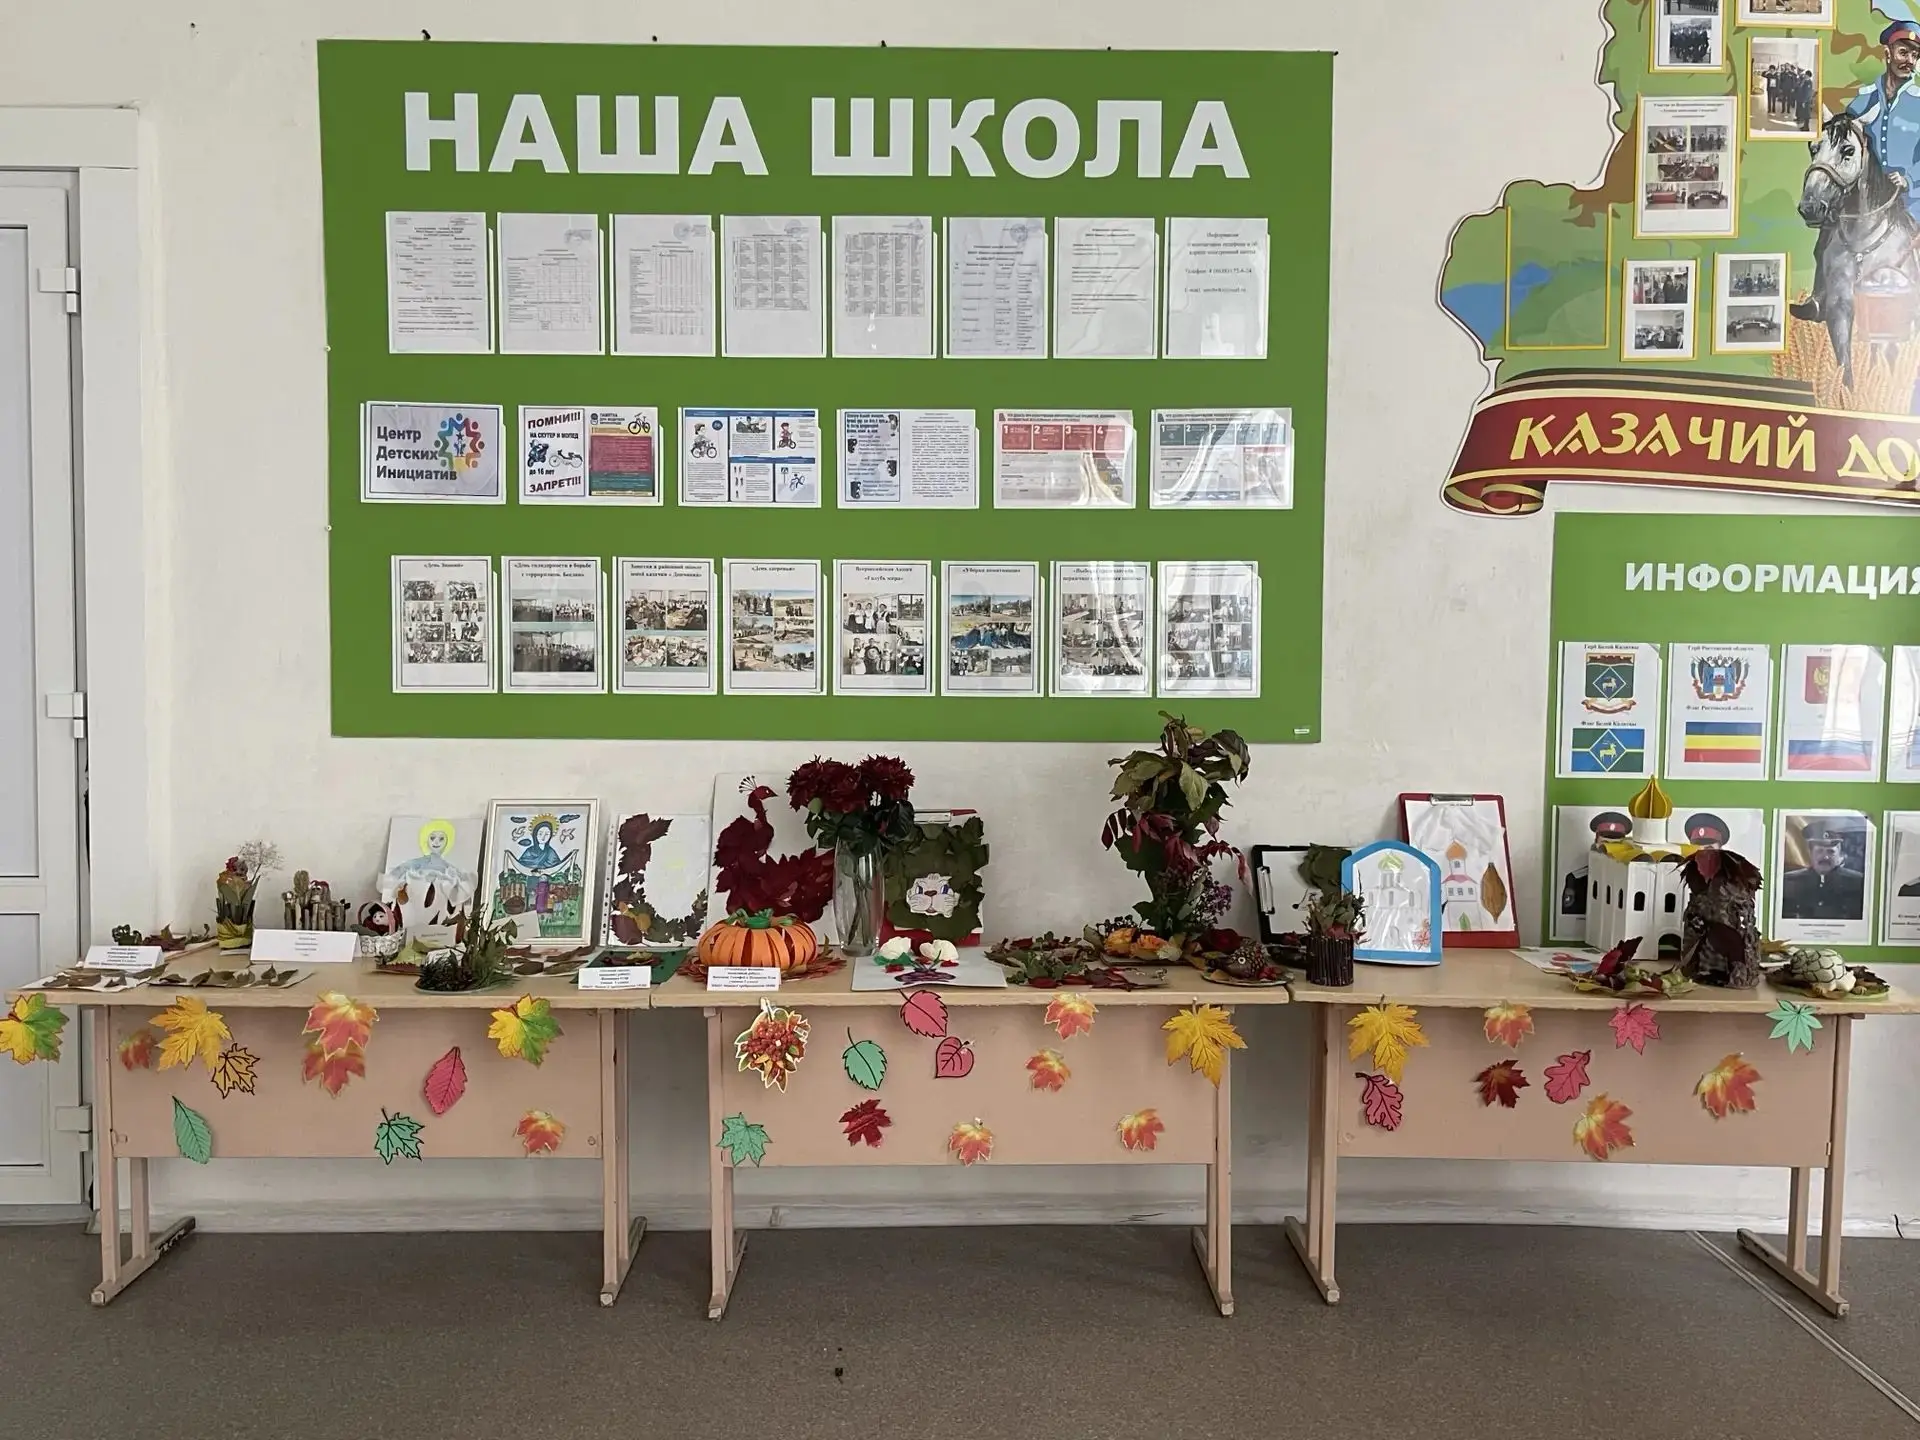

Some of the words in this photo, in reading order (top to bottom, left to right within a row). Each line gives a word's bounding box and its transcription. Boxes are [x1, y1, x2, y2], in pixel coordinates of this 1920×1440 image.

[404, 91, 769, 176] НАША
[811, 97, 1251, 179] ШКОЛА
[527, 411, 581, 430] ПОМНИ!!!
[376, 426, 422, 443] Центр
[1003, 426, 1009, 434] 1
[1034, 426, 1041, 434] 2
[1065, 426, 1072, 434] 3
[1097, 426, 1104, 434] 4
[1161, 425, 1166, 433] 1
[1510, 411, 1817, 472] КАЗАЧИЙ
[376, 446, 439, 461] Детских
[1836, 433, 1920, 482] ДО
[376, 465, 458, 481] Инициатив
[529, 476, 581, 494] ЗАПРЕТ!!!
